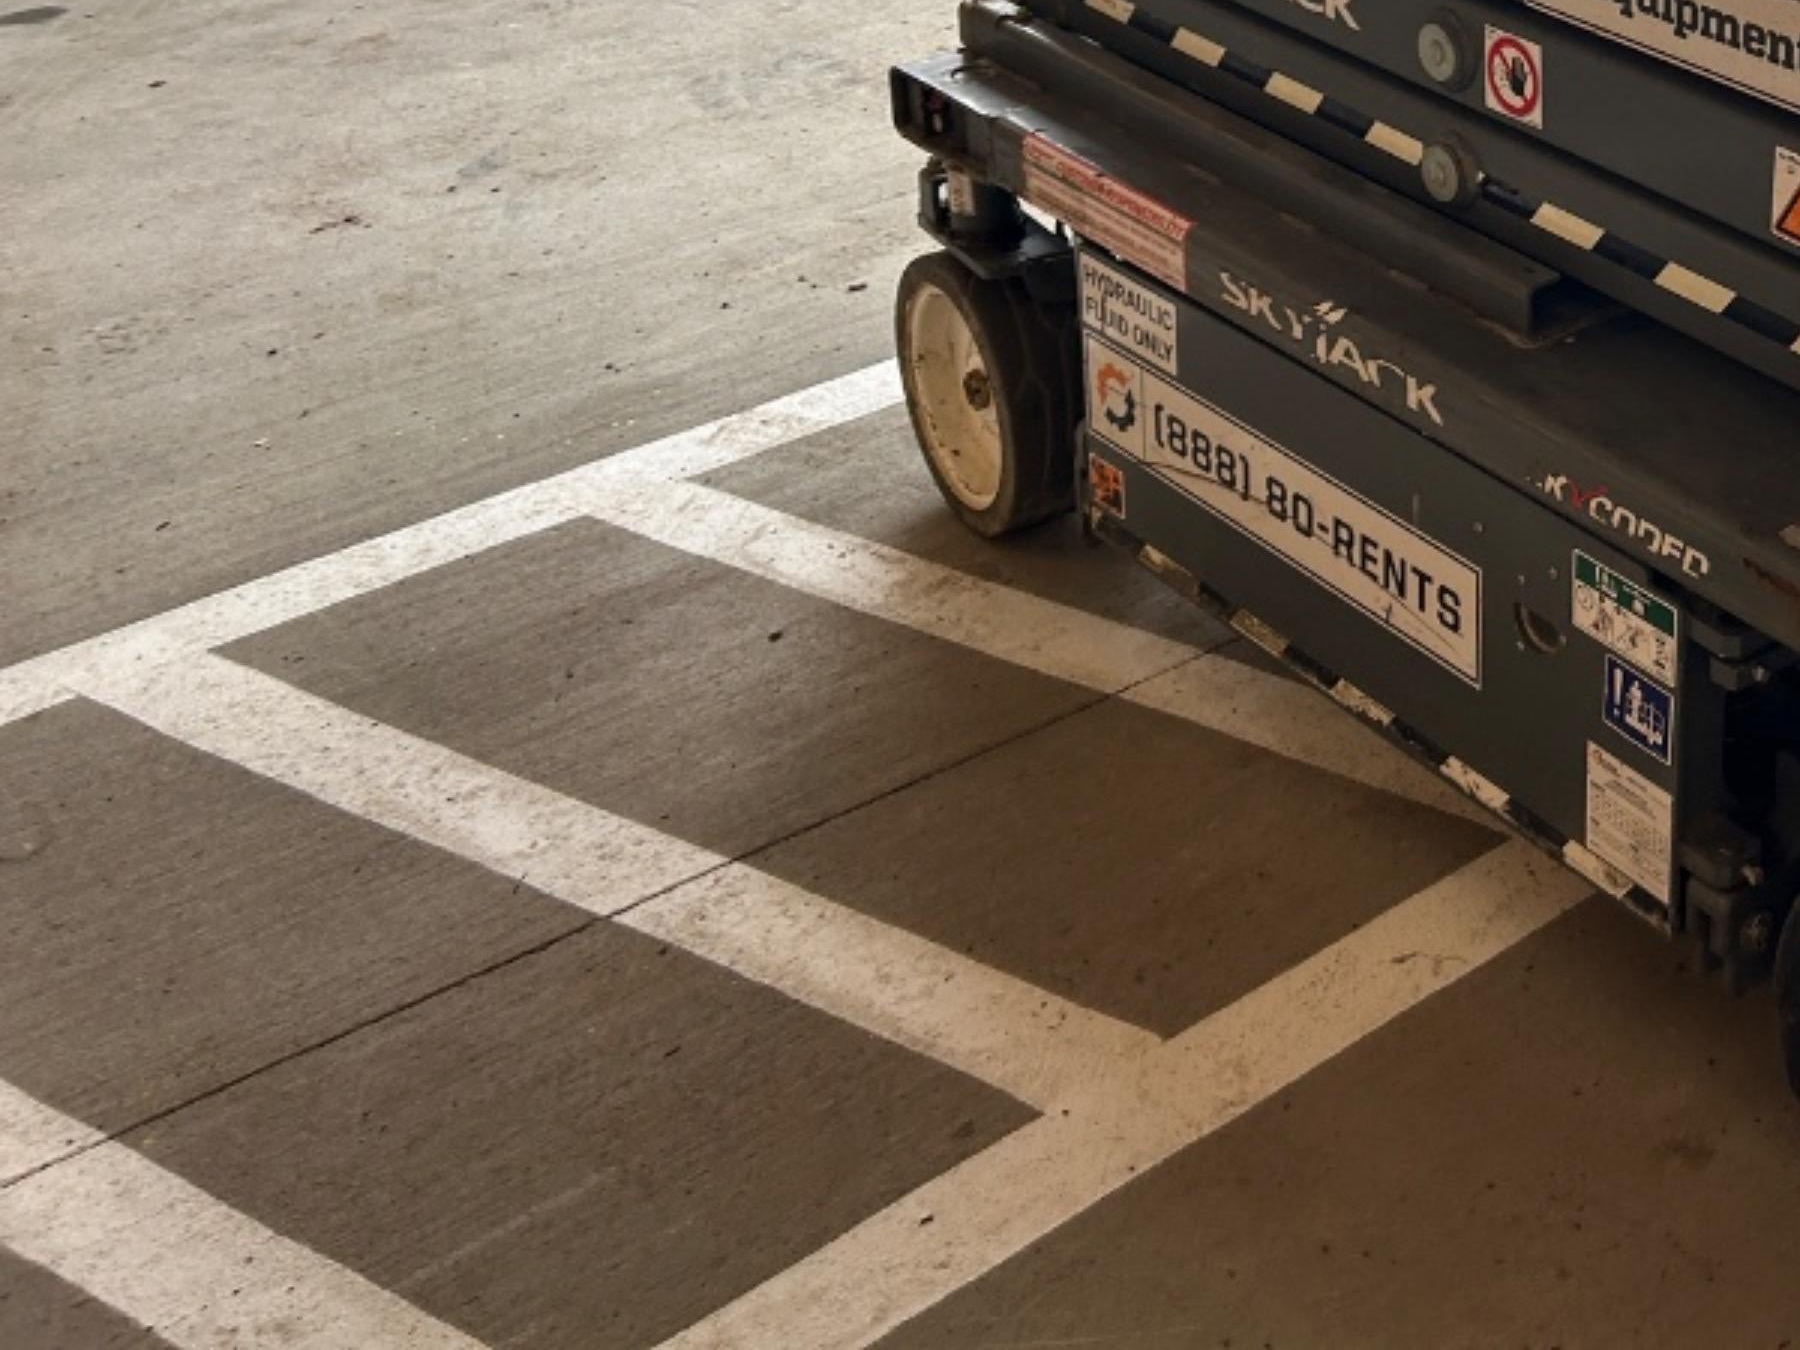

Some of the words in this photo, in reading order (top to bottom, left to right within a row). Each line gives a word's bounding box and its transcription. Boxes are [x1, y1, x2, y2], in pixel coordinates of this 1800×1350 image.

[1084, 263, 1173, 331] HYDRAULIC
[1085, 295, 1129, 337] FLUID
[1133, 324, 1174, 363] ONLY
[1153, 403, 1252, 502] (888)
[1264, 474, 1463, 635] 80-RENTS
[1524, 474, 1709, 579] KYCODED
